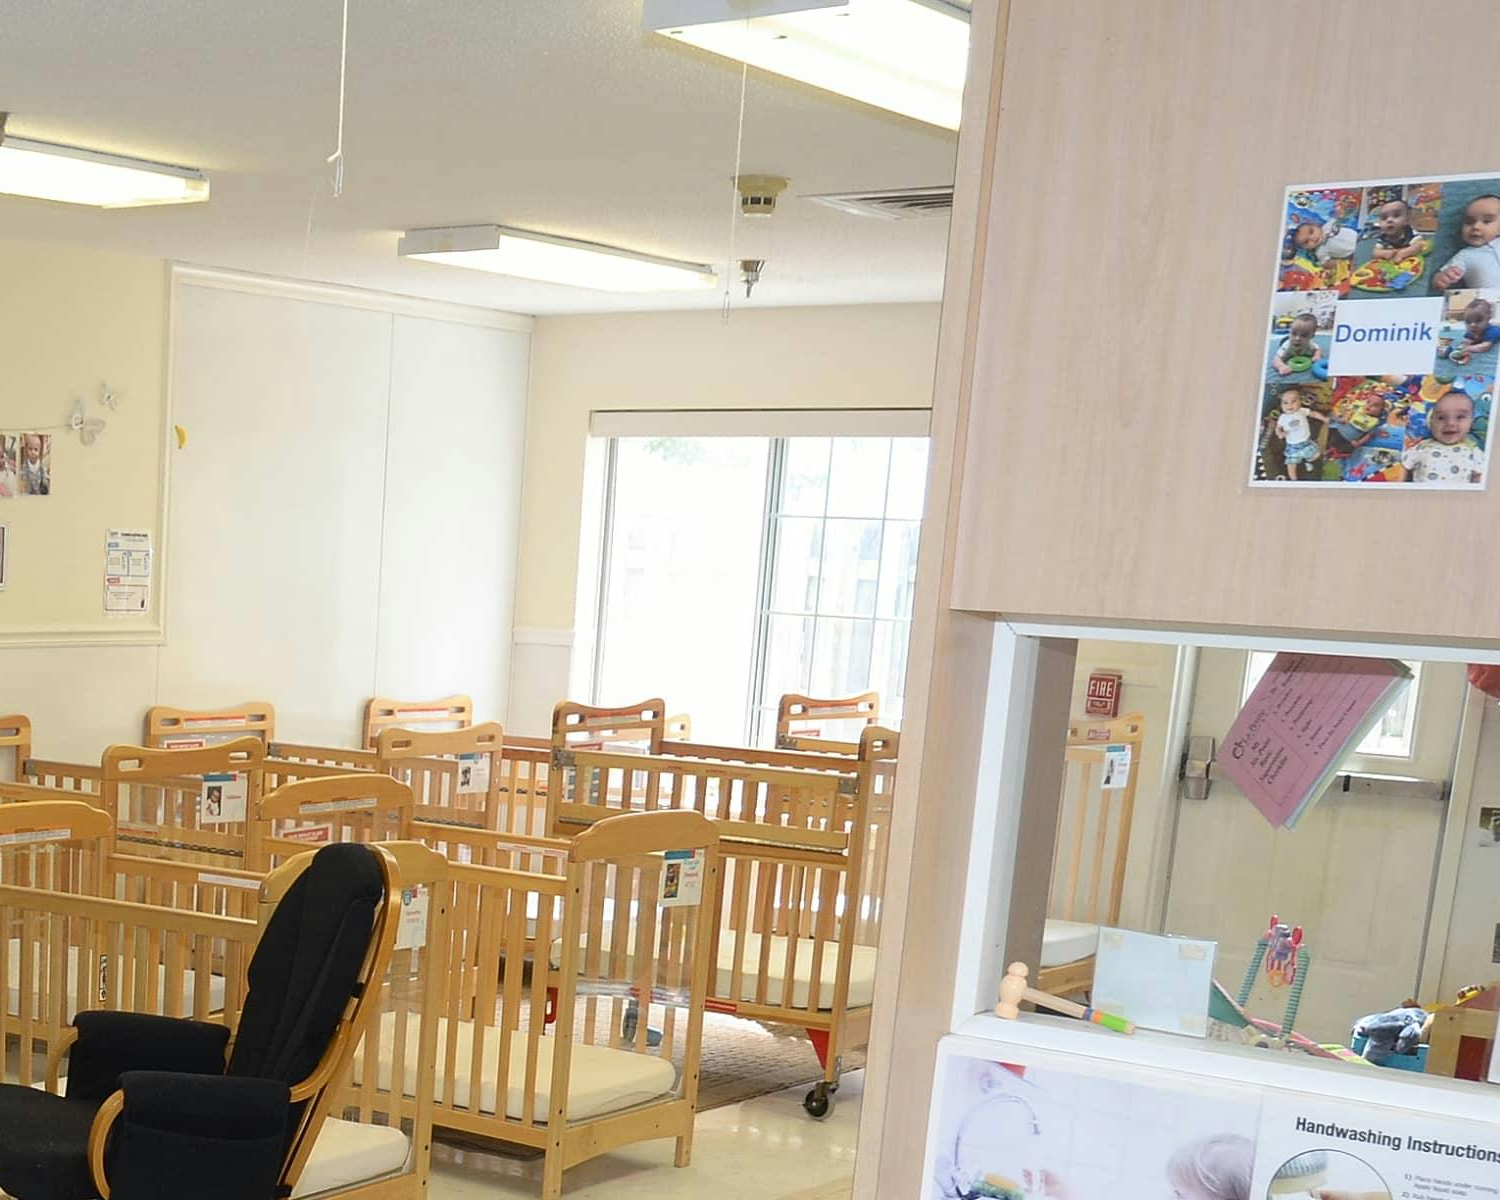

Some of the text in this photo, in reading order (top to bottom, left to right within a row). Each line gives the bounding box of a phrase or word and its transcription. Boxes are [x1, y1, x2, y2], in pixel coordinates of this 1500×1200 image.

[1335, 322, 1432, 343] Dominik
[1089, 680, 1113, 698] FIRE
[1295, 1116, 1500, 1164] Handwashing Instructions
